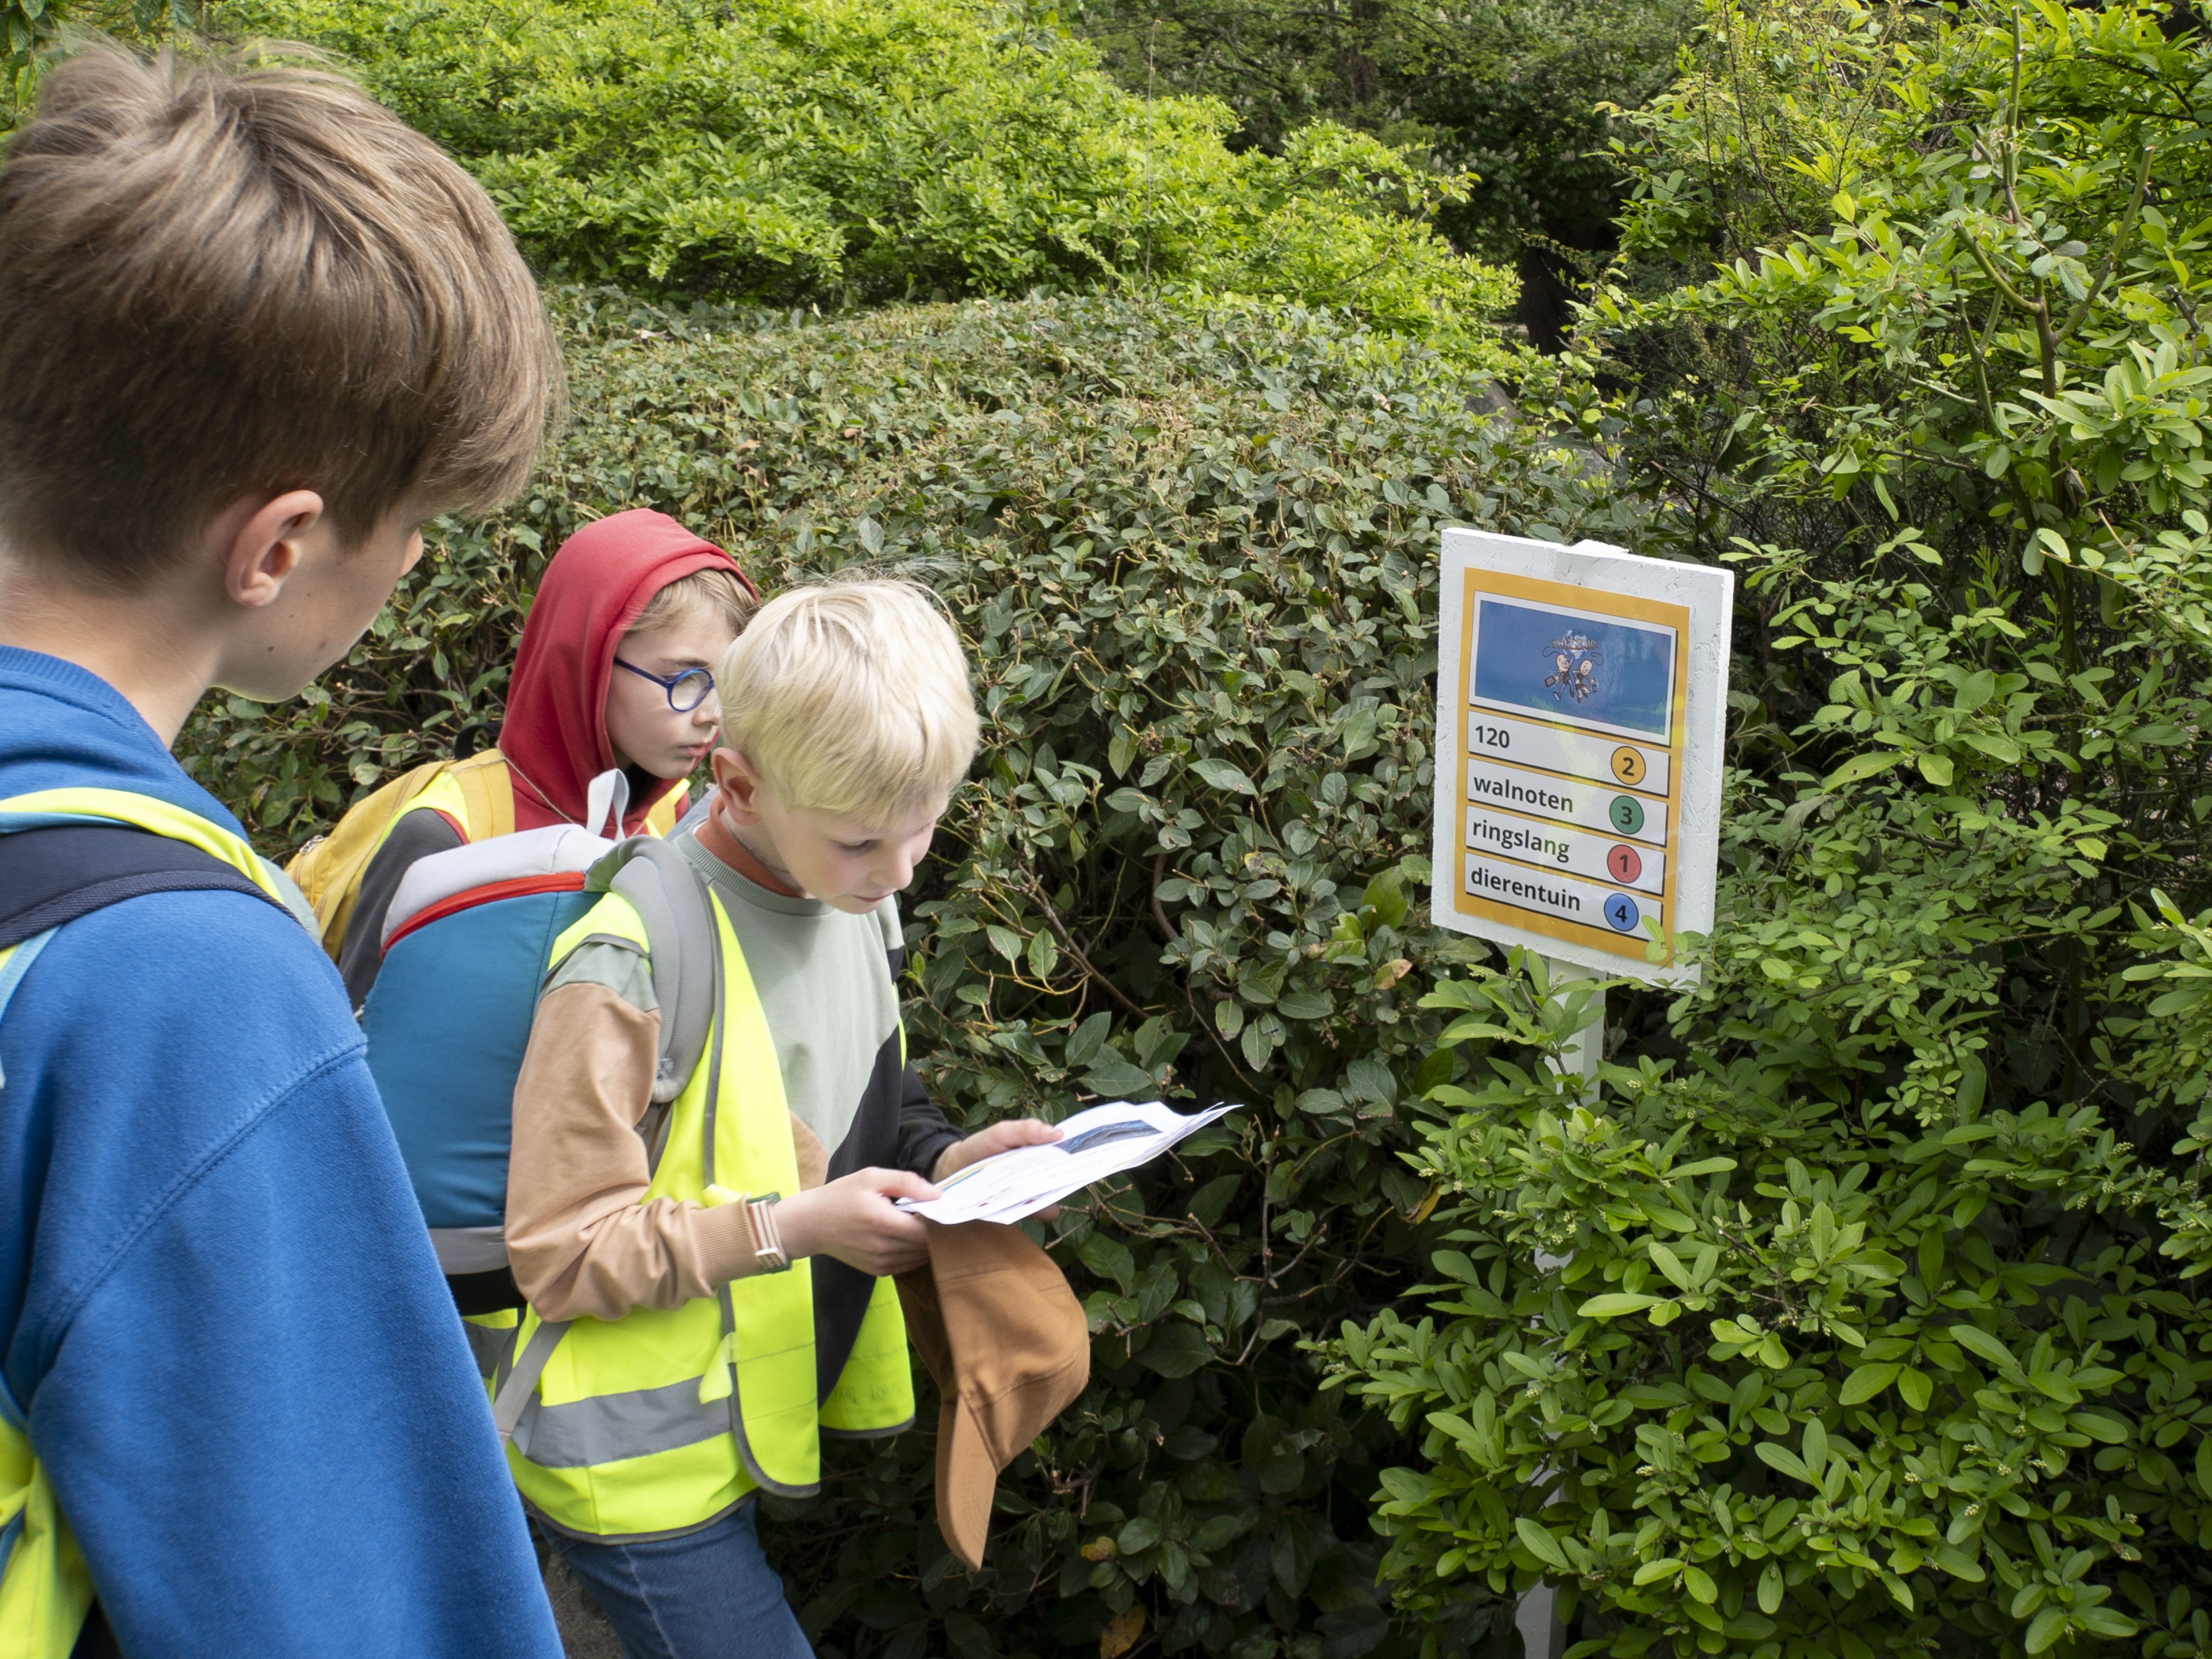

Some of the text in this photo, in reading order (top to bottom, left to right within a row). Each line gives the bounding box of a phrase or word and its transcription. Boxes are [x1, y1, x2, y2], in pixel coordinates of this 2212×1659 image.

[1475, 725, 1509, 748] 120
[1622, 756, 1634, 777] 2
[1473, 777, 1573, 813] walnoten
[1620, 805, 1633, 825] 3
[1473, 819, 1570, 863] ringslang
[1619, 854, 1628, 873] 1
[1471, 867, 1580, 911] dierentuin
[1614, 905, 1627, 923] 4
